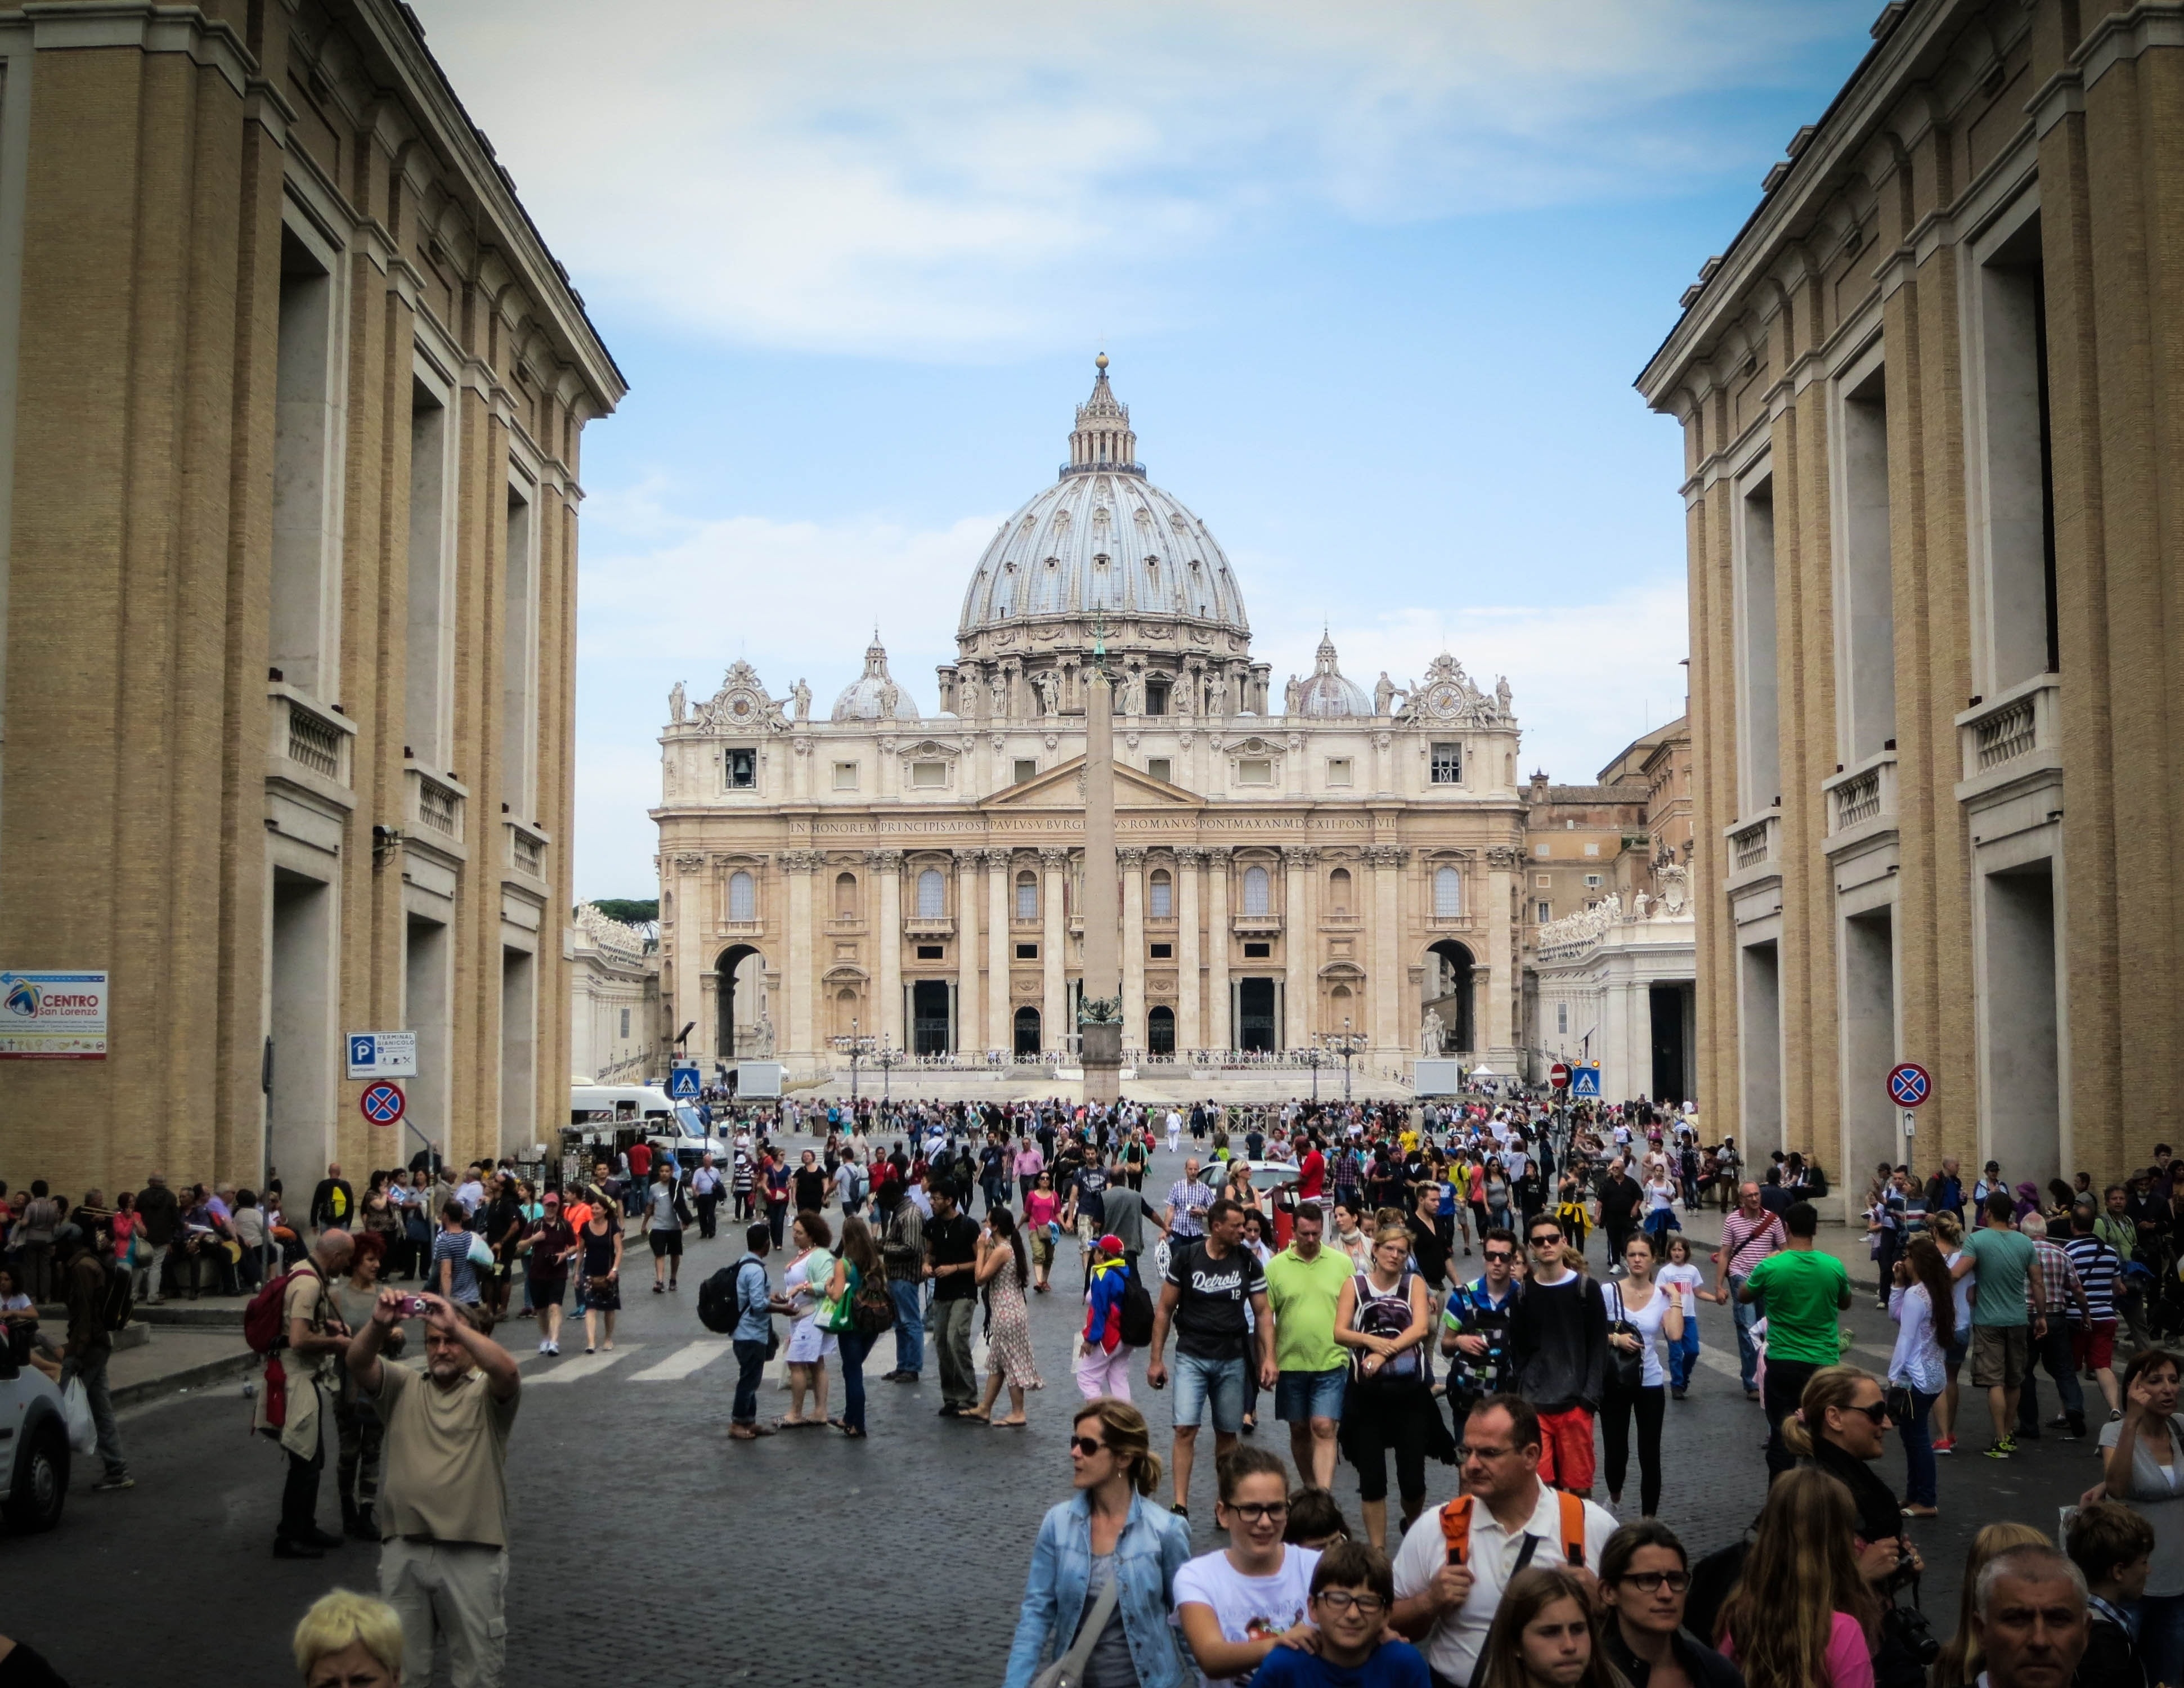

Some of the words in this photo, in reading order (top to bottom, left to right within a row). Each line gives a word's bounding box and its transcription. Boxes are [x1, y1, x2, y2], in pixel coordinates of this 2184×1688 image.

[791, 823, 805, 833] IN
[812, 823, 877, 833] HONOREM
[1130, 818, 1196, 829] ROMANVS
[1376, 818, 1395, 828] VII
[42, 995, 98, 1007] CENTRO
[39, 1007, 56, 1016] San
[60, 1007, 98, 1016] Lorenzo
[357, 1045, 370, 1061] P
[1192, 1271, 1242, 1289] Detroit
[1231, 1289, 1241, 1300] 12
